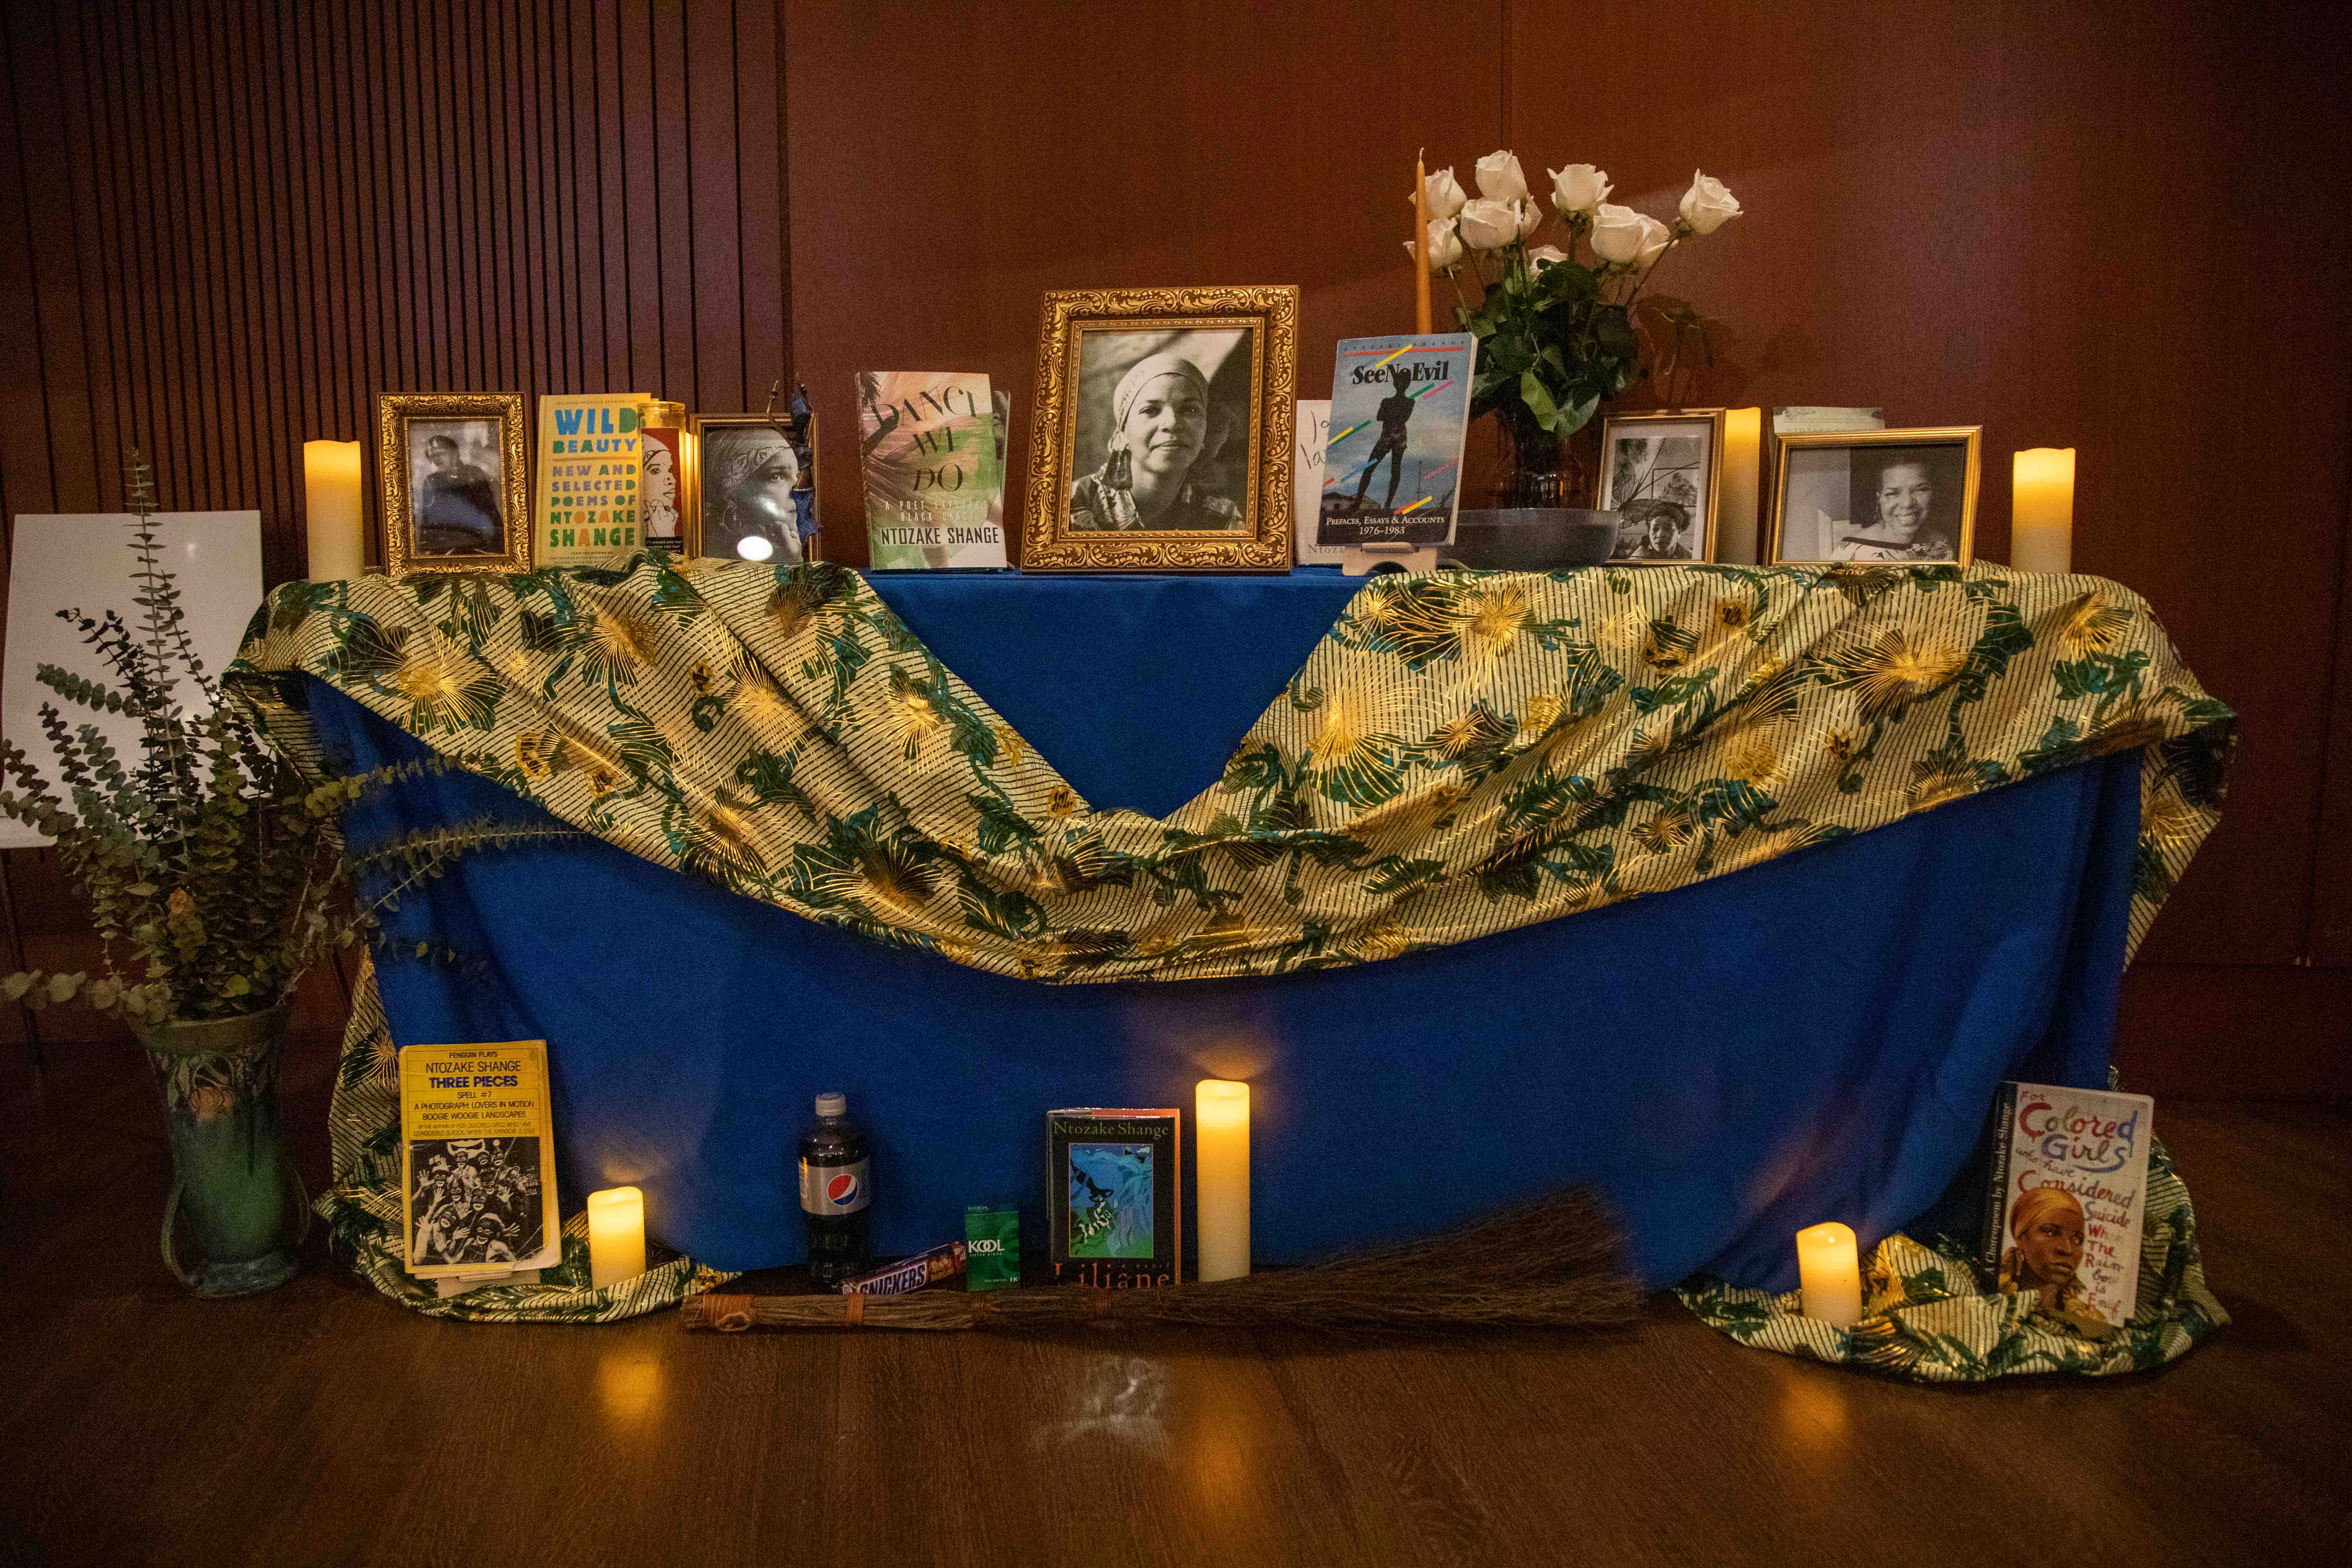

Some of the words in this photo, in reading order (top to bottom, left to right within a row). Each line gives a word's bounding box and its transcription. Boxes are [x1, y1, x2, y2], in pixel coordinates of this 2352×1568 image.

[555, 408, 638, 435] WILD
[553, 439, 637, 454] BEAUTY
[552, 465, 591, 476] NEW
[599, 464, 637, 475] AND
[913, 463, 963, 492] DO
[552, 480, 636, 492] SELECTED
[551, 496, 608, 508] POEMS
[614, 495, 636, 506] OF
[885, 501, 890, 510] A
[900, 501, 925, 510] POET
[934, 500, 988, 509] EXPLORES
[550, 510, 635, 524] NTOZAKE
[900, 512, 932, 521] BLACK
[942, 512, 974, 521] DANCE
[1364, 516, 1390, 525] ESSAYS
[1401, 516, 1445, 524] ACCOUNTS
[550, 528, 635, 547] SHANGE
[881, 527, 941, 545] NTOZAKE
[948, 526, 999, 544] SHANGE
[426, 1062, 474, 1074] NTOZAKE
[478, 1061, 521, 1072] SHANGE
[429, 1077, 469, 1089] THREE
[473, 1075, 518, 1088] PIECES
[1997, 1102, 2010, 1139] Shange
[1054, 1122, 1115, 1135] Ntozake
[1117, 1122, 1169, 1140] Shange
[2019, 1102, 2138, 1158] Colored
[2042, 1134, 2128, 1173] Girls
[1992, 1142, 2007, 1183] Ntozake
[1991, 1186, 2005, 1198] by
[2084, 1201, 2131, 1229] Suicide
[968, 1239, 1005, 1253] KOOL
[2088, 1240, 2115, 1258] The
[860, 1264, 926, 1294] SNICKERS
